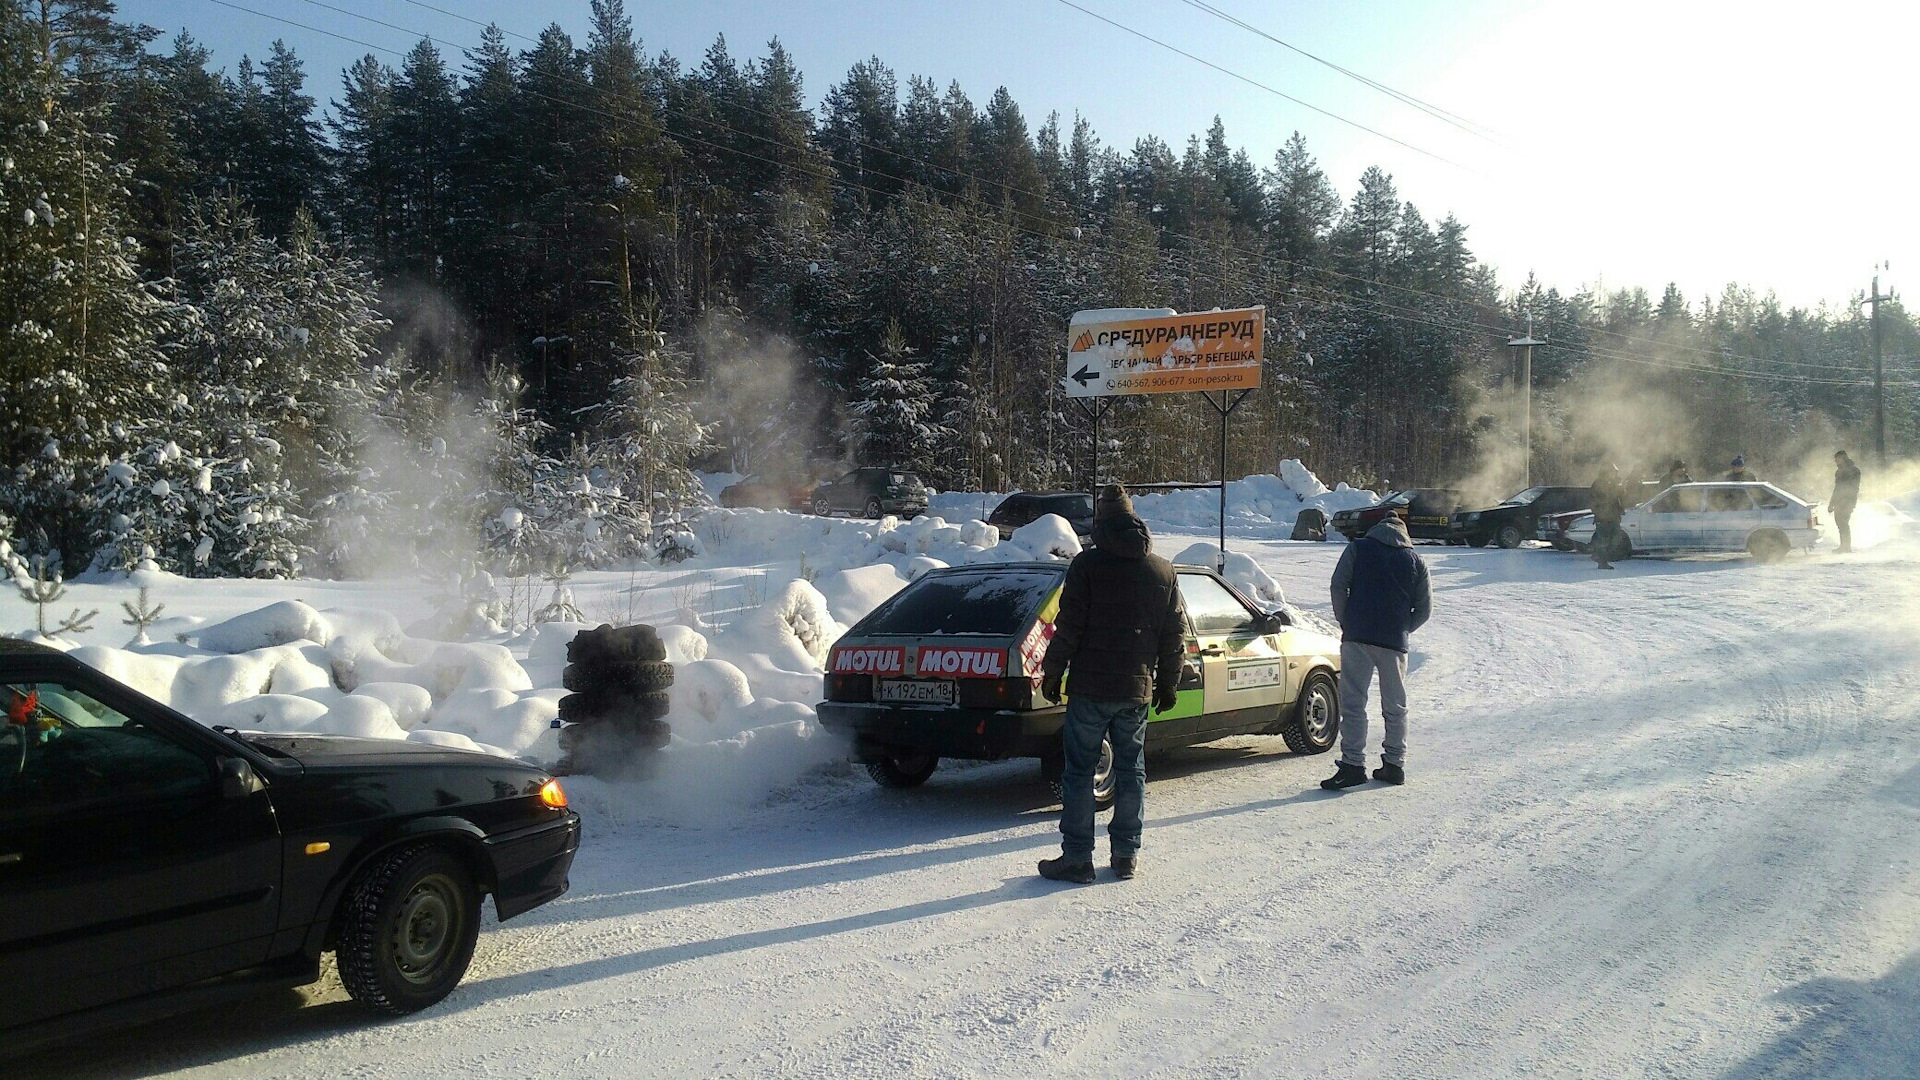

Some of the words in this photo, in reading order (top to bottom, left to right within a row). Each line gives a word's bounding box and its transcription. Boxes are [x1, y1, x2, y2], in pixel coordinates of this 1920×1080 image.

[1163, 353, 1203, 367] РЬЕР
[1205, 350, 1255, 363] БЕГЕШКА
[1152, 376, 1185, 387] 906-677
[1188, 373, 1243, 385] sun-pesok.ru
[1021, 619, 1046, 656] MOTUL
[835, 650, 902, 671] MOTUL
[920, 650, 1003, 676] MOTUL
[1026, 635, 1051, 674] MOTUL
